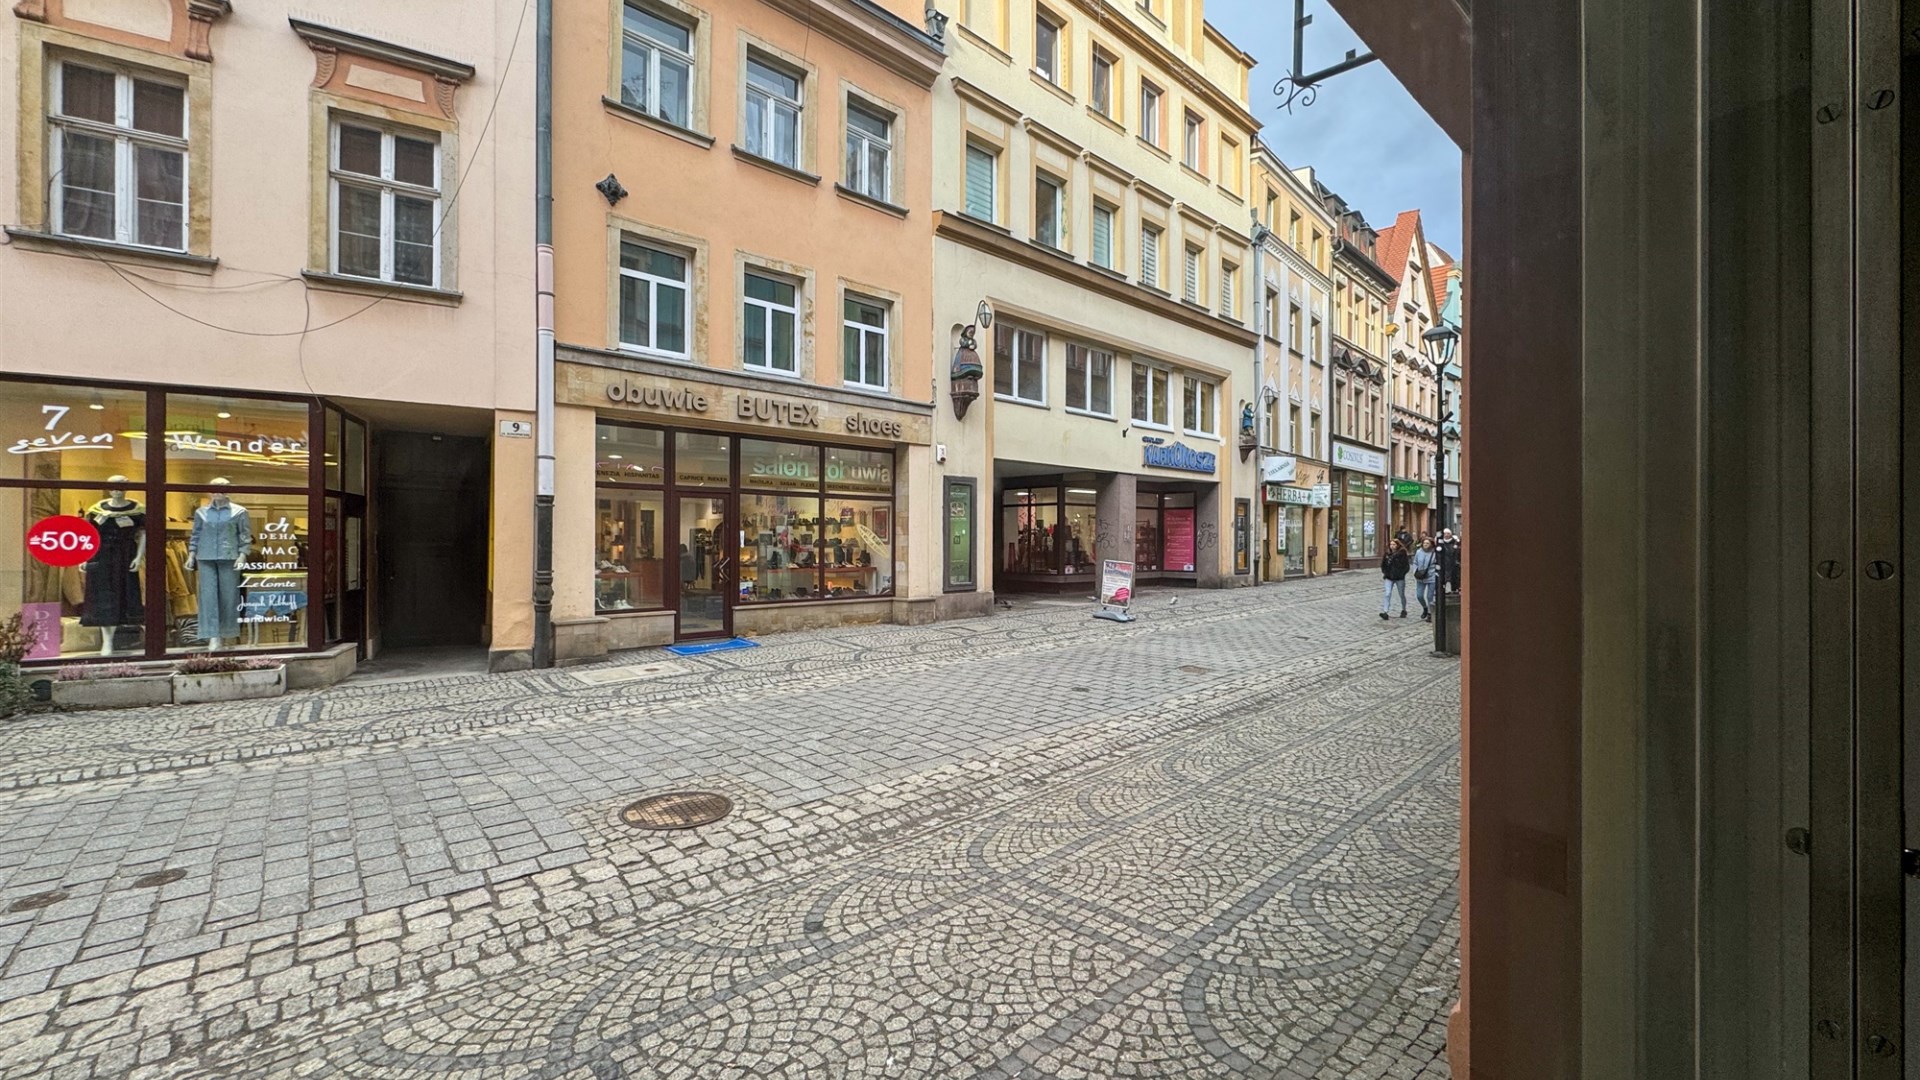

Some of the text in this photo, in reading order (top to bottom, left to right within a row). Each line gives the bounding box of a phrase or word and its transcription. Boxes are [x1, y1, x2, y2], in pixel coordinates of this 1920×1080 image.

[41, 405, 70, 430] 7
[607, 379, 901, 437] obuwie BUTEX shoes
[512, 422, 520, 433] 9
[8, 432, 113, 454] seven
[173, 433, 301, 453] Wonder
[753, 455, 809, 478] salon
[1276, 486, 1302, 503] HERBA
[261, 546, 299, 555] MAC
[236, 562, 298, 570] PASSIGATTI
